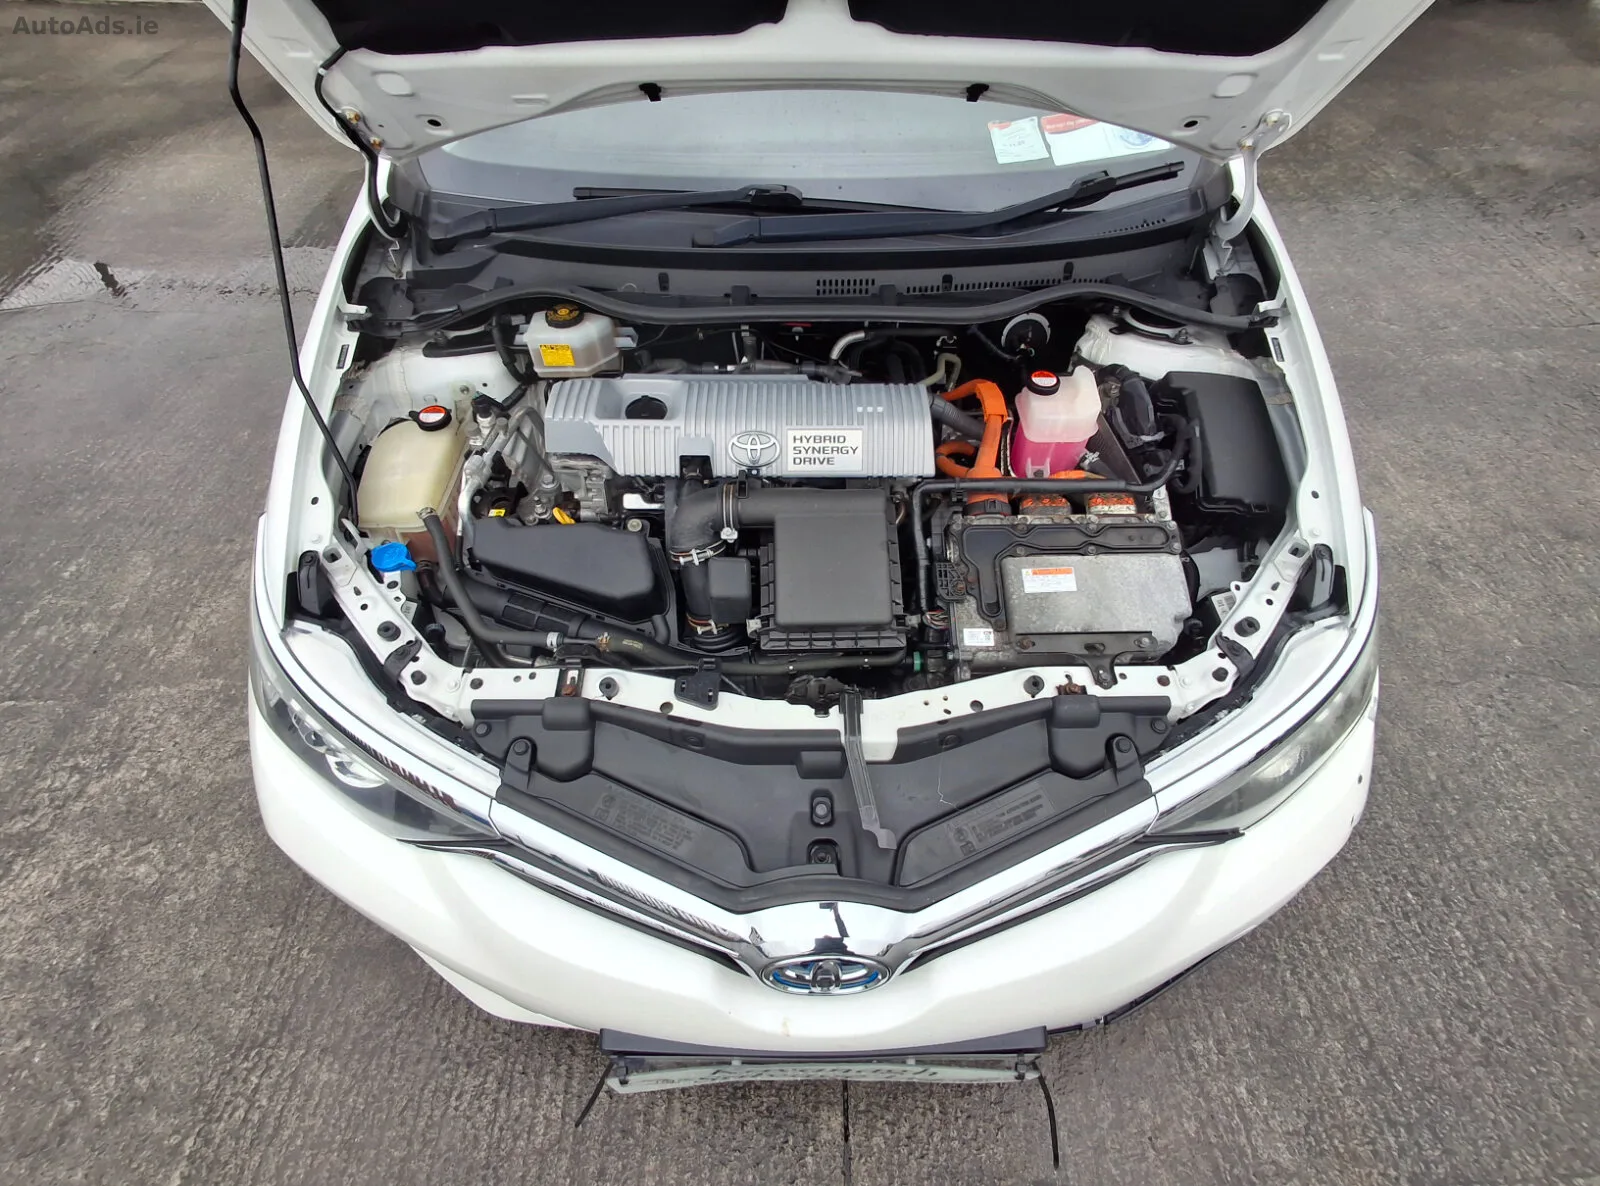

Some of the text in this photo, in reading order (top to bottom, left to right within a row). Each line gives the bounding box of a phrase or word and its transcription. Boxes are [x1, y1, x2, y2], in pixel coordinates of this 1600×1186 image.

[792, 435, 846, 444] HYBRID
[792, 446, 859, 455] SYNERGY
[792, 457, 835, 466] DRIVE
